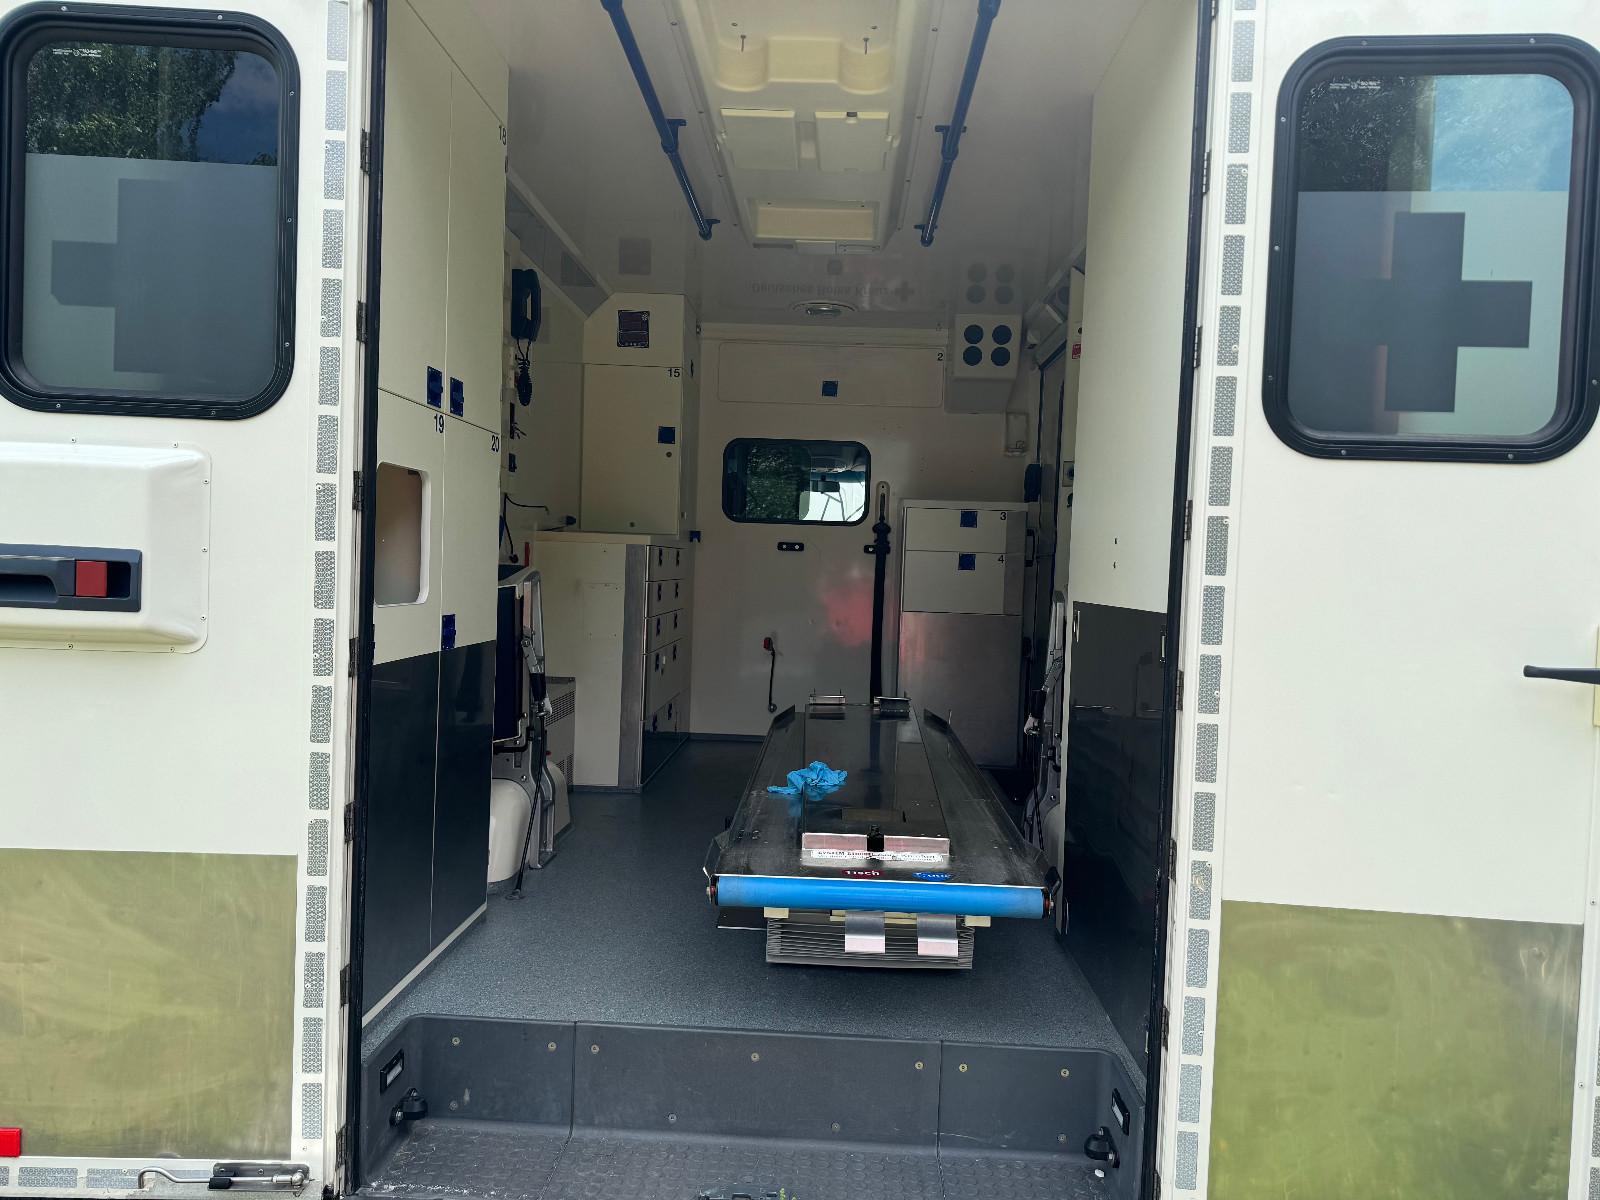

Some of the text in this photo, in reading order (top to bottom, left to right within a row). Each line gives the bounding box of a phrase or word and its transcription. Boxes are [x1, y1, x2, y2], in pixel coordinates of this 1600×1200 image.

[498, 125, 507, 146] 18
[937, 352, 944, 361] 2
[667, 367, 681, 378] 15
[434, 413, 445, 434] 19
[491, 434, 500, 453] 20
[1000, 511, 1007, 521] 3
[997, 554, 1005, 564] 4
